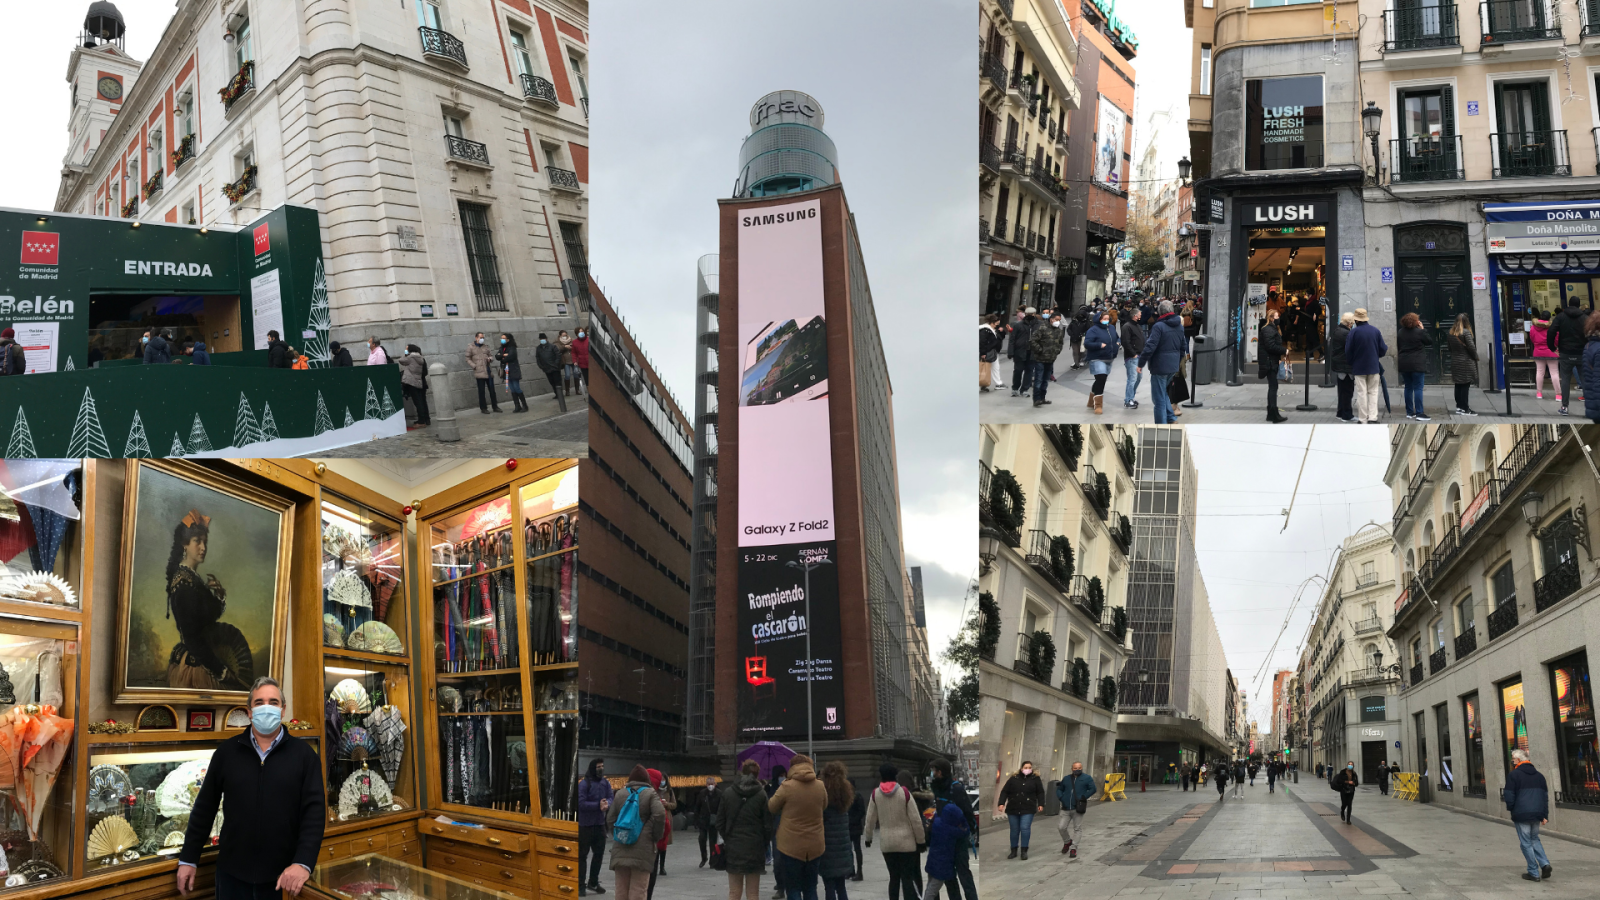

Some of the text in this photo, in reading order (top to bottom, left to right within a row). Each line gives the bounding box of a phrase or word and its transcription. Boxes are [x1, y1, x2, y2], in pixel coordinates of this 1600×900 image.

[756, 100, 815, 125] fnac
[1264, 105, 1304, 118] LUSH
[1264, 118, 1304, 129] FRESH
[1264, 129, 1304, 137] HANDMADE
[743, 207, 817, 227] SAMSUNG
[1255, 205, 1314, 222] LUSH
[1547, 209, 1583, 220] DOÑA
[1527, 223, 1598, 235] Doña Manolita
[1217, 237, 1227, 248] 24
[19, 266, 59, 274] Comunidad
[124, 259, 214, 278] ENTRADA
[0, 295, 74, 314] Belén
[744, 519, 829, 536] Galaxy Z Fold2
[744, 554, 749, 563] 5
[756, 554, 766, 562] 22
[747, 584, 805, 610] Rompiendo
[766, 610, 774, 621] el
[752, 610, 807, 639] cascarón
